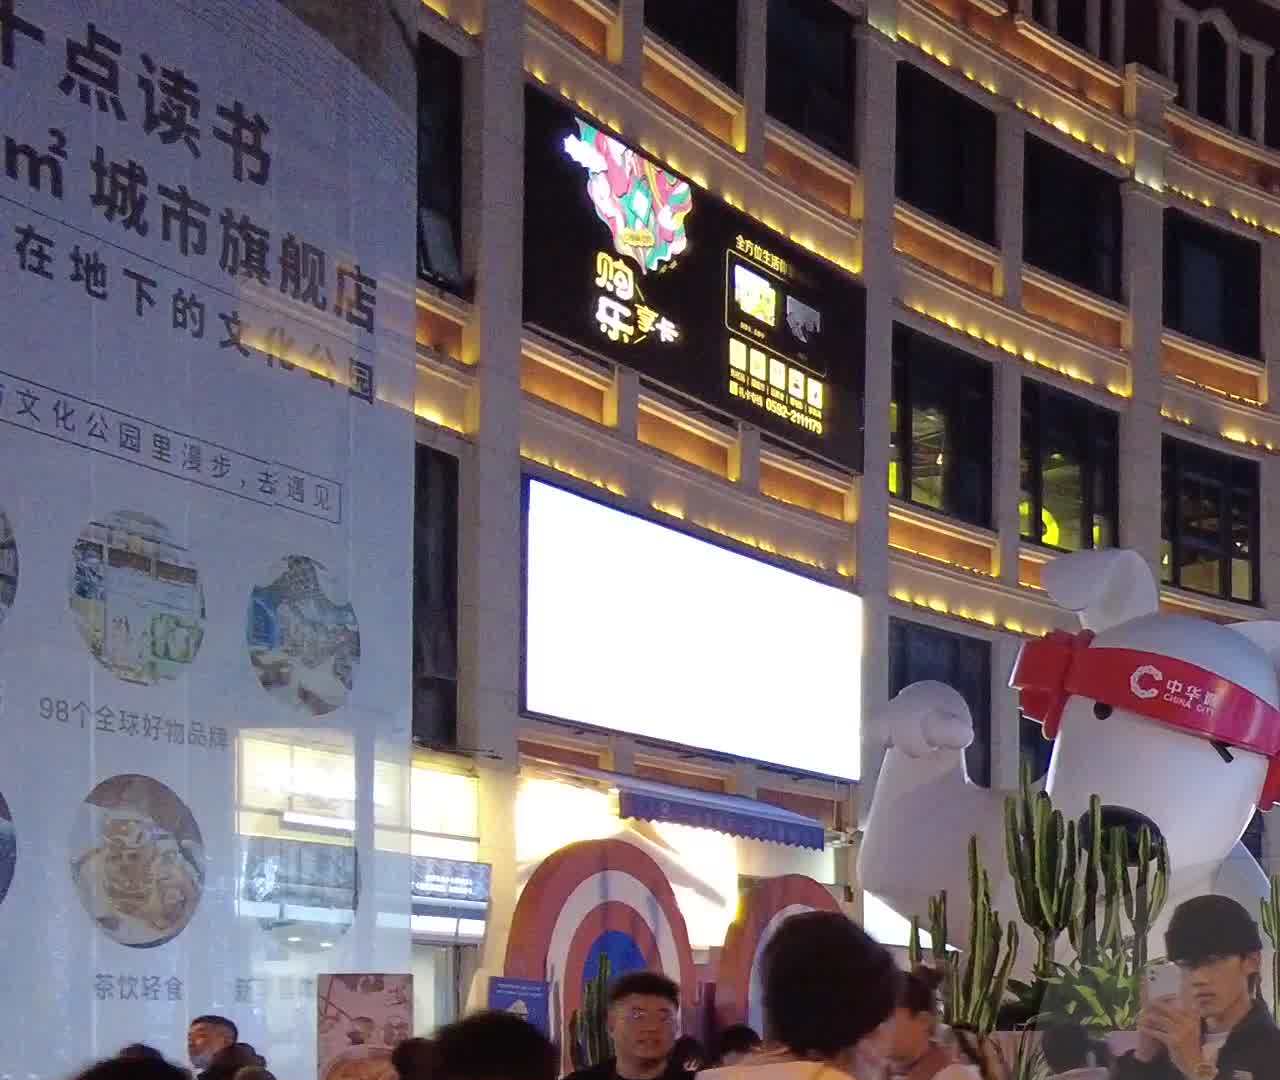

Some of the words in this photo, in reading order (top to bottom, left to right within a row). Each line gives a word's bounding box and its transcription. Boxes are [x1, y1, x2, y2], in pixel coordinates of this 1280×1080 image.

[39, 696, 230, 750] 98个全球好物品牌
